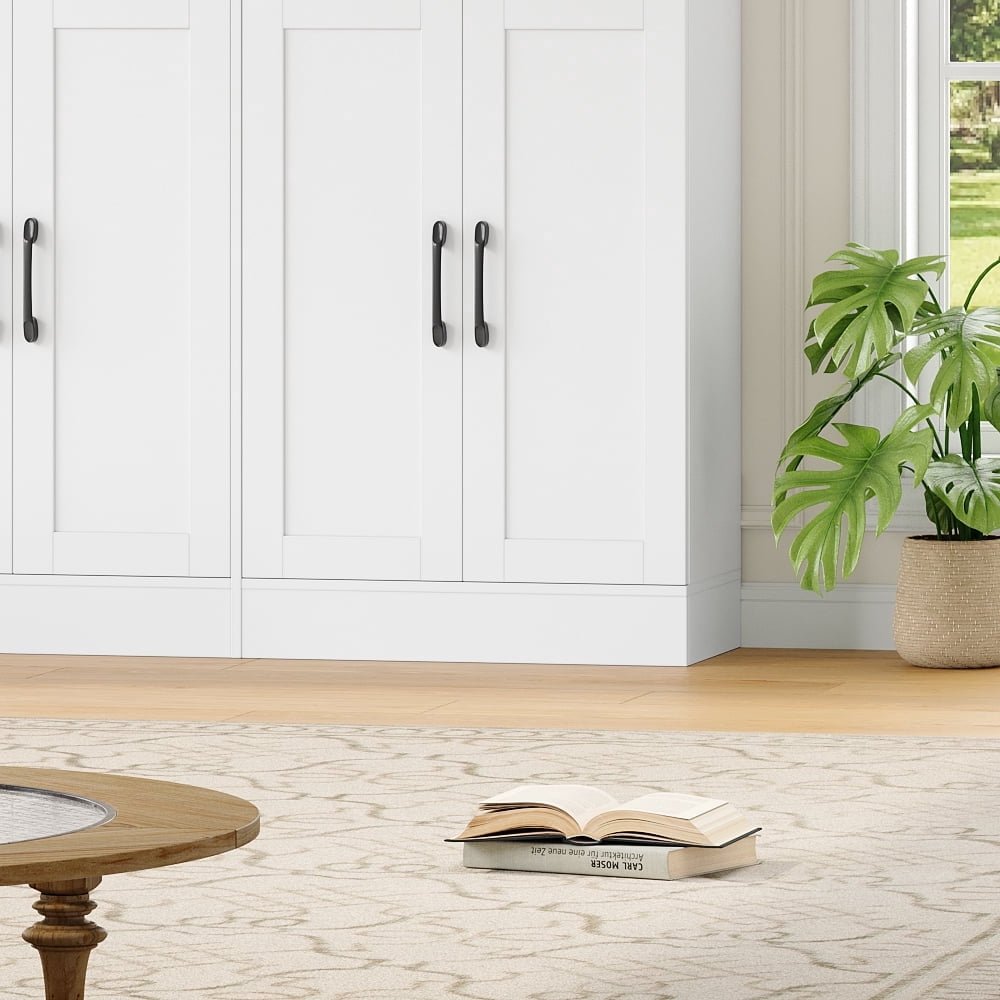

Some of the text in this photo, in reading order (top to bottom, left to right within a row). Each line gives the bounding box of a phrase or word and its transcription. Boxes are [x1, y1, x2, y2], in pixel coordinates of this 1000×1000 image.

[569, 849, 585, 858] eine
[601, 851, 644, 862] Architektur
[590, 859, 643, 871] CARL MOSER
